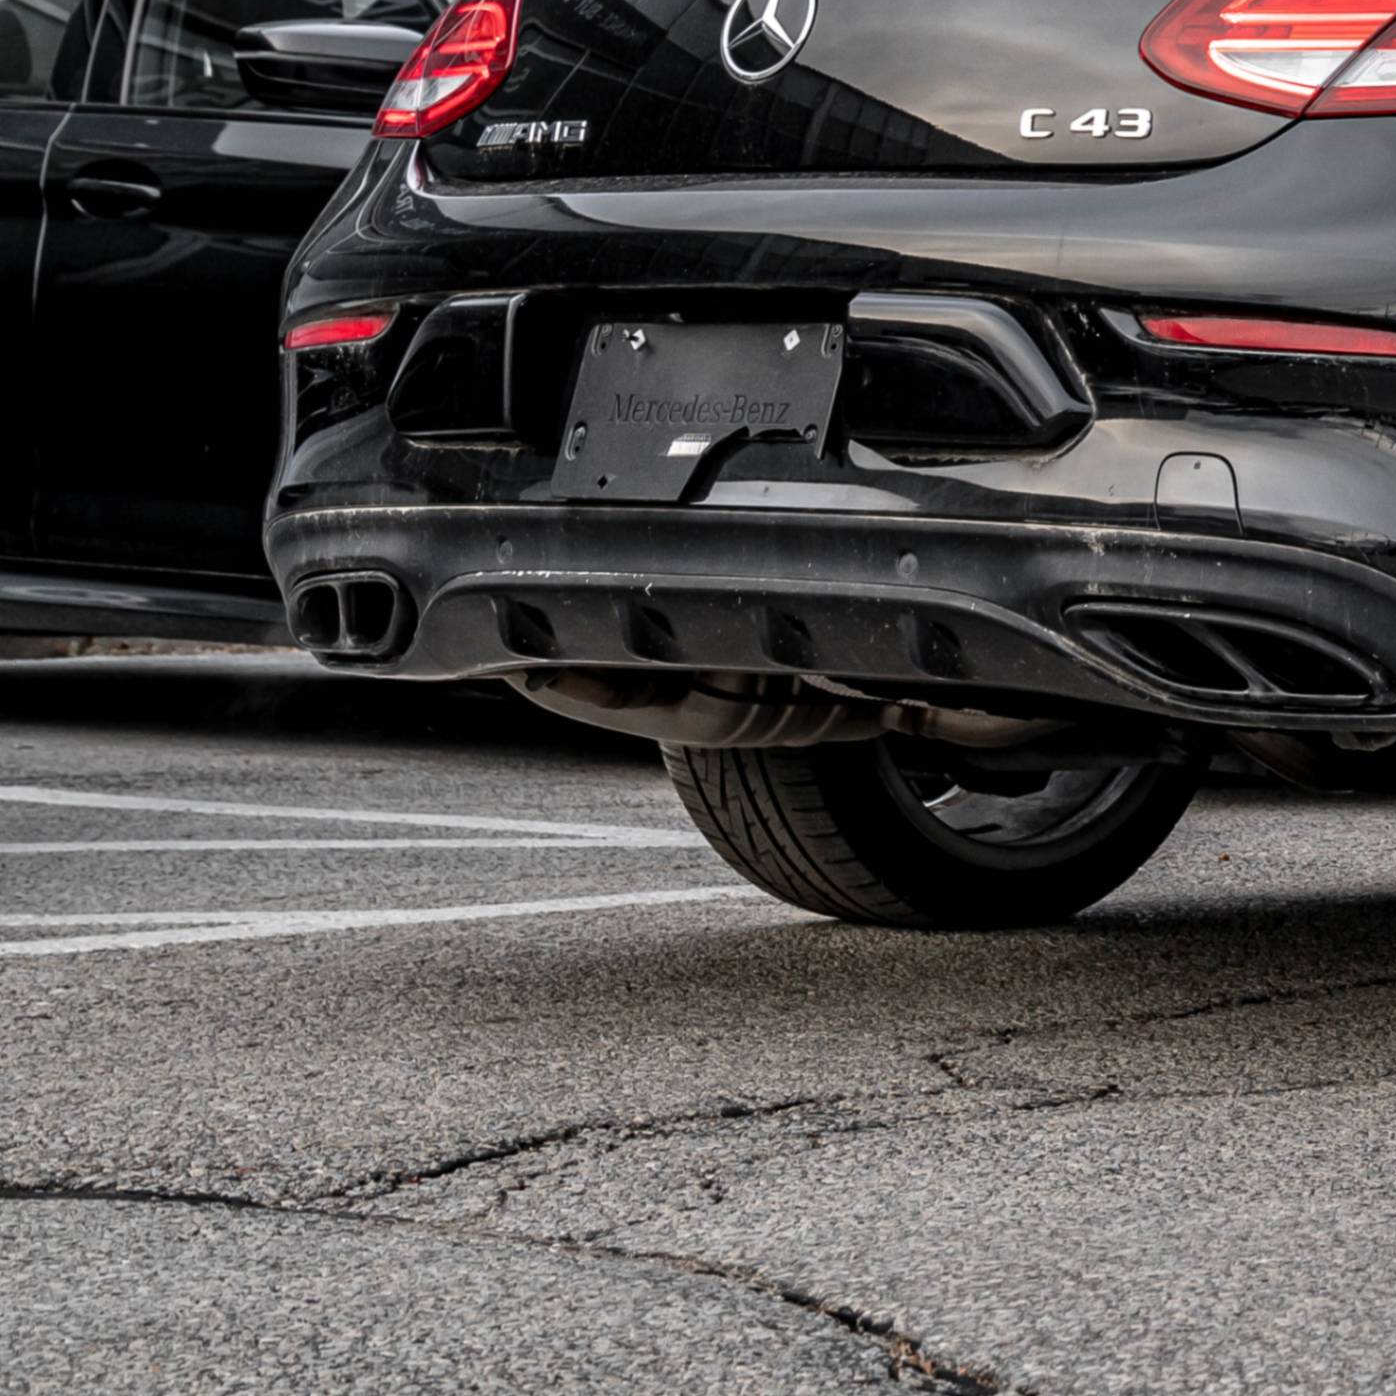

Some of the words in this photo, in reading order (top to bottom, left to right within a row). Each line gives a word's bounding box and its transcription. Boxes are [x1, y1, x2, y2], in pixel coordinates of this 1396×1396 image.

[512, 120, 588, 144] AMG
[1020, 107, 1056, 139] C
[1069, 107, 1153, 139] 43
[607, 393, 792, 425] Mercedes-Benz
